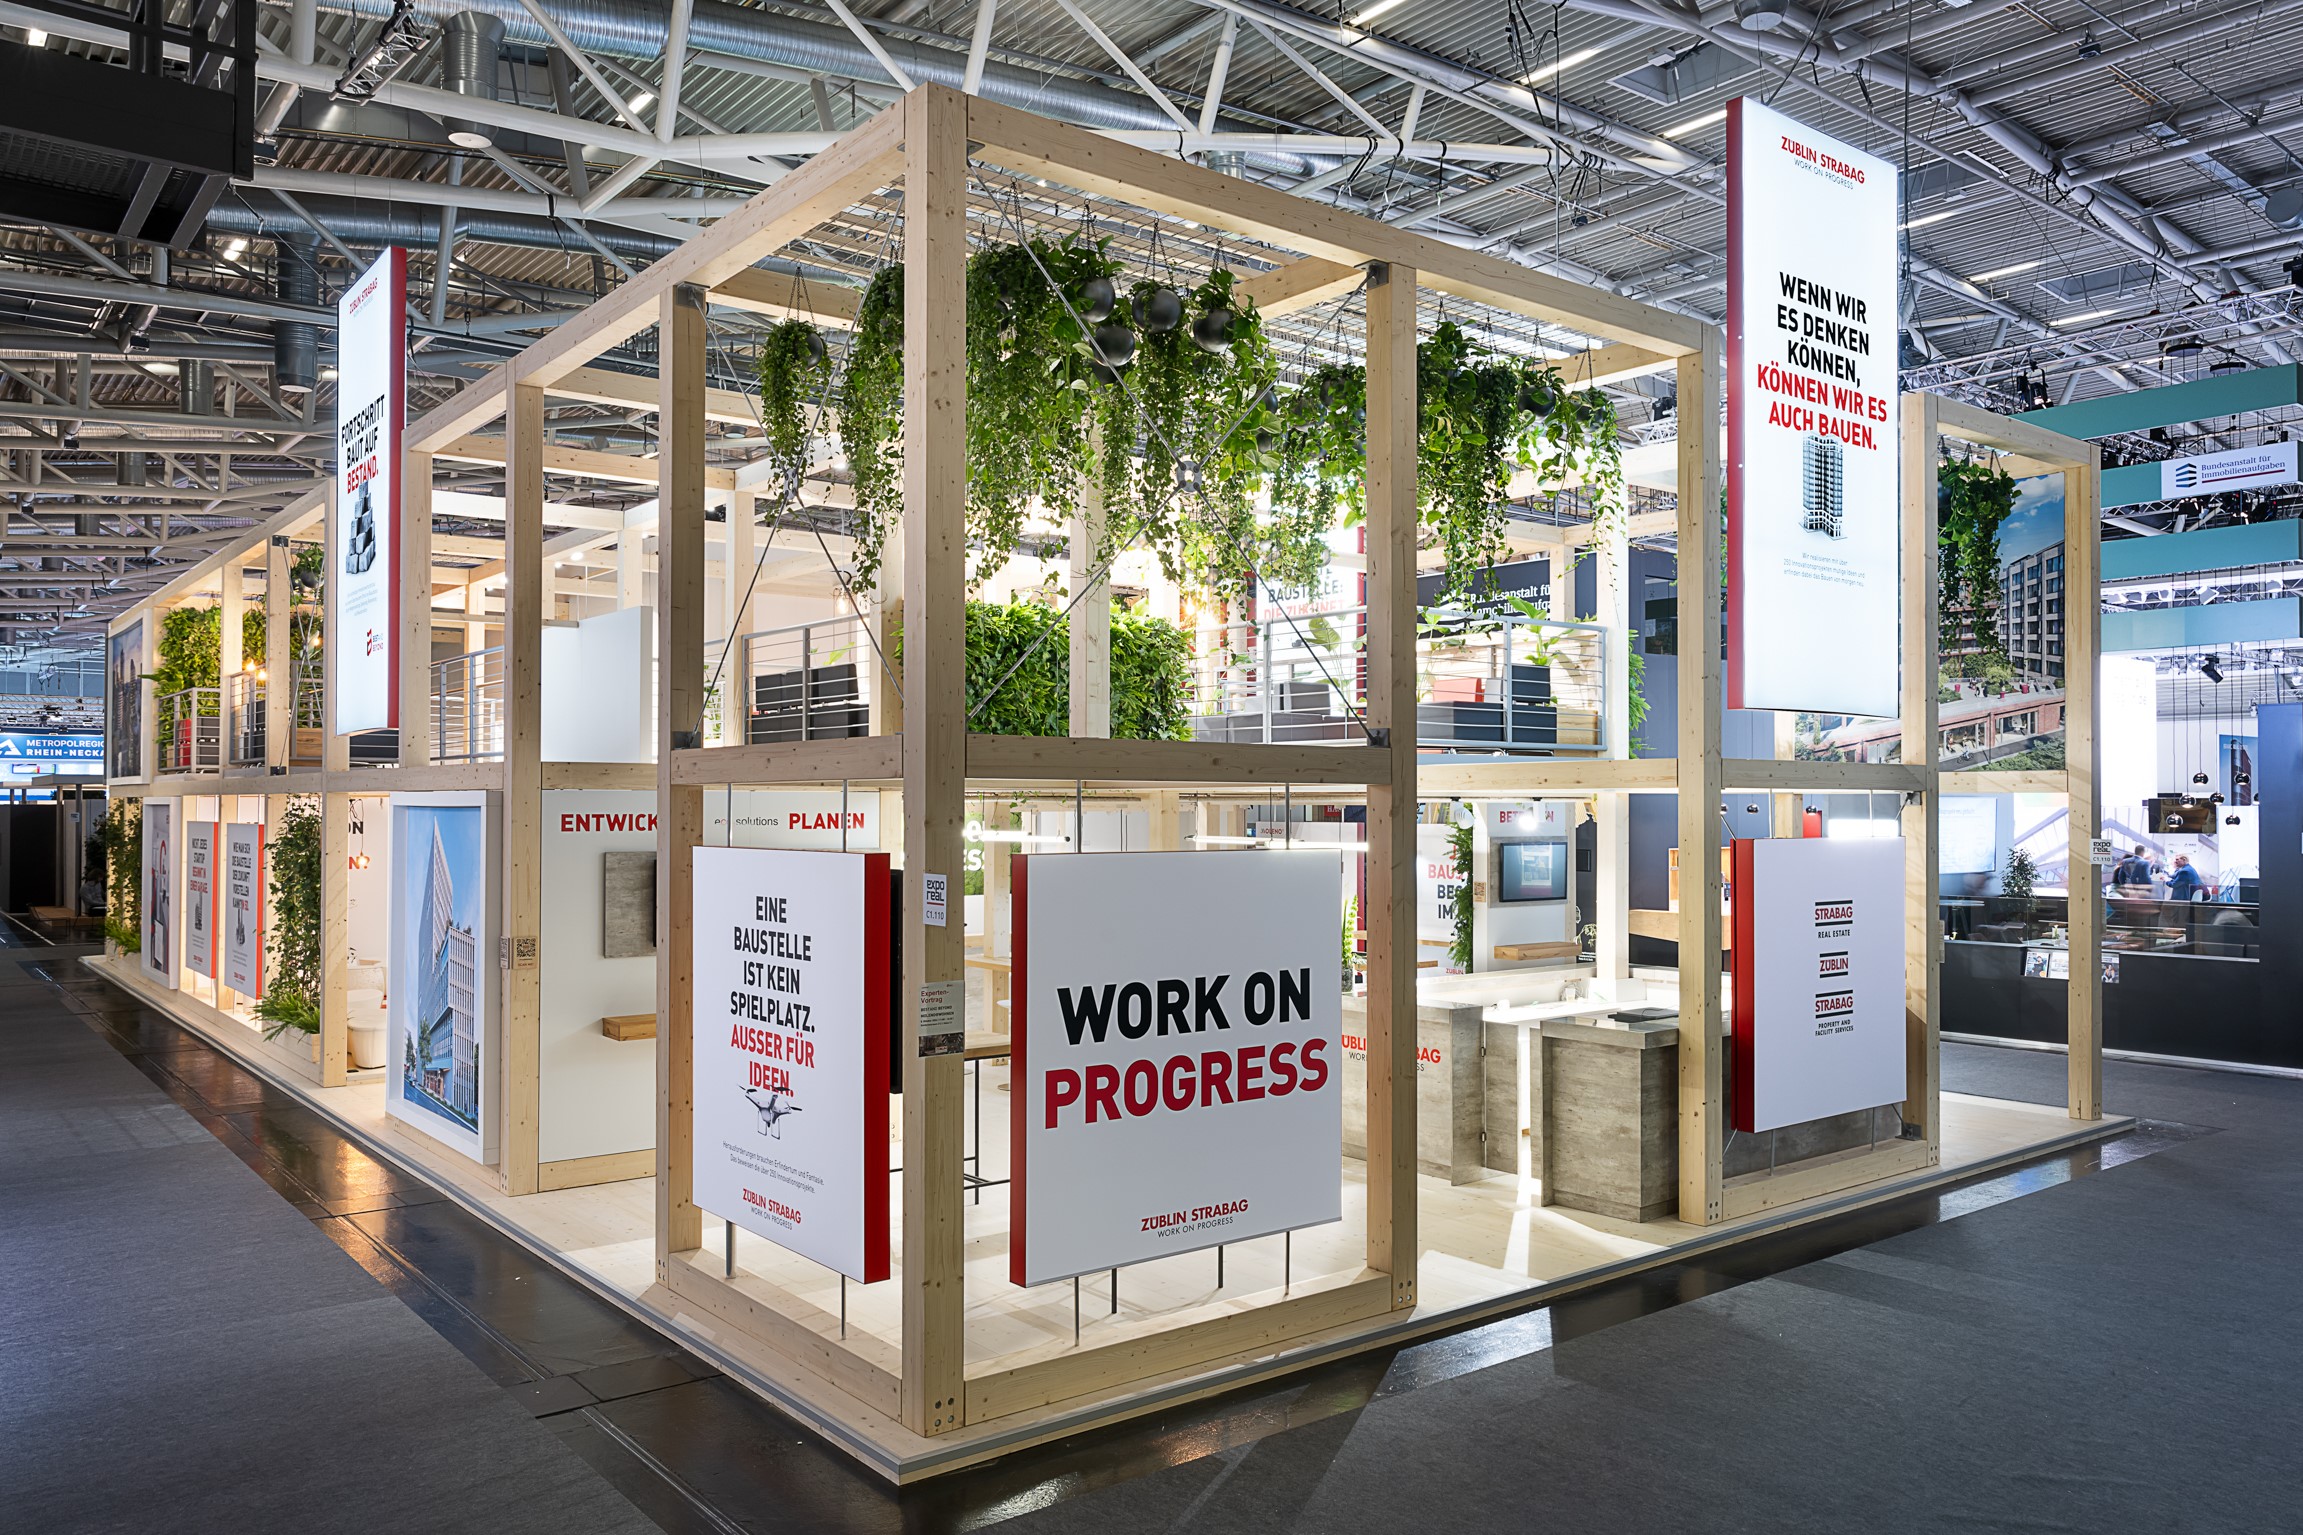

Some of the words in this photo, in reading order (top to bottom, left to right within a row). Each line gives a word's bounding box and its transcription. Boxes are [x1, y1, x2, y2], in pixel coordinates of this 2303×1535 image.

[1794, 158, 1812, 172] WORK
[1814, 167, 1823, 177] ON
[1826, 172, 1854, 190] PROGRESS
[1821, 153, 1865, 184] STRABAG
[1780, 272, 1831, 312] WENN
[1836, 291, 1867, 324] WIR
[1778, 304, 1798, 333] ES
[1804, 312, 1869, 356] DENKEN
[1788, 337, 1861, 389] KÖNNEN,
[1758, 361, 1828, 407] KÖNNEN
[1832, 385, 1864, 417] WIR
[1868, 396, 1887, 422] ES
[341, 394, 385, 448] FORTSCHRITT
[1769, 401, 1813, 431] AUCH
[1819, 413, 1877, 451] BAUEN.
[347, 437, 364, 469] BAUT
[364, 426, 378, 457] AUF
[2202, 457, 2256, 471] Bundesanstalt
[347, 455, 379, 495] BESTAND.
[2202, 462, 2285, 479] Immobilienaufgaben
[736, 817, 779, 826] solutions
[789, 813, 865, 830] PLANEN
[927, 880, 945, 892] expo
[756, 896, 787, 923] EINE
[926, 911, 945, 920] C1.110
[1815, 906, 1853, 920] STRABAG
[734, 926, 811, 962] BAUSTELLE
[1818, 931, 1831, 939] REAL
[1833, 929, 1851, 938] ESTATE
[744, 961, 764, 987] IST
[767, 964, 800, 995] KEIN
[730, 991, 815, 1033] SPIELPLATZ.
[1057, 974, 1230, 1046] WORK
[1244, 967, 1311, 1026] ON
[1816, 996, 1854, 1013] STRABAG
[1815, 1028, 1834, 1037] FACILITY
[1835, 1025, 1854, 1034] SERVICES
[1818, 1021, 1840, 1029] PROPERTY
[731, 1024, 783, 1060] AUSSER
[786, 1031, 815, 1069] FÜR
[749, 1061, 794, 1098] IDEEN.
[1045, 1038, 1328, 1130] PROGRESS
[723, 1141, 756, 1160] Herausforderungen
[756, 1153, 774, 1166] brauchen
[774, 1159, 798, 1176] Erfindertum
[798, 1169, 806, 1179] und
[806, 1171, 825, 1186] Fantasie.
[738, 1157, 754, 1170] beweisen
[760, 1165, 769, 1176] über
[769, 1169, 777, 1179] 250
[777, 1172, 815, 1194] Innovationsprojekte.
[751, 1205, 763, 1217] WORK
[763, 1211, 771, 1220] ON
[772, 1215, 793, 1231] PROGRESS
[769, 1199, 802, 1224] STRABAG
[1141, 1211, 1187, 1232] ZÜBLIN
[1191, 1199, 1249, 1222] STRABAG
[1158, 1227, 1181, 1238] WORK
[1182, 1224, 1195, 1234] ON
[1197, 1217, 1234, 1230] PROGRESS
